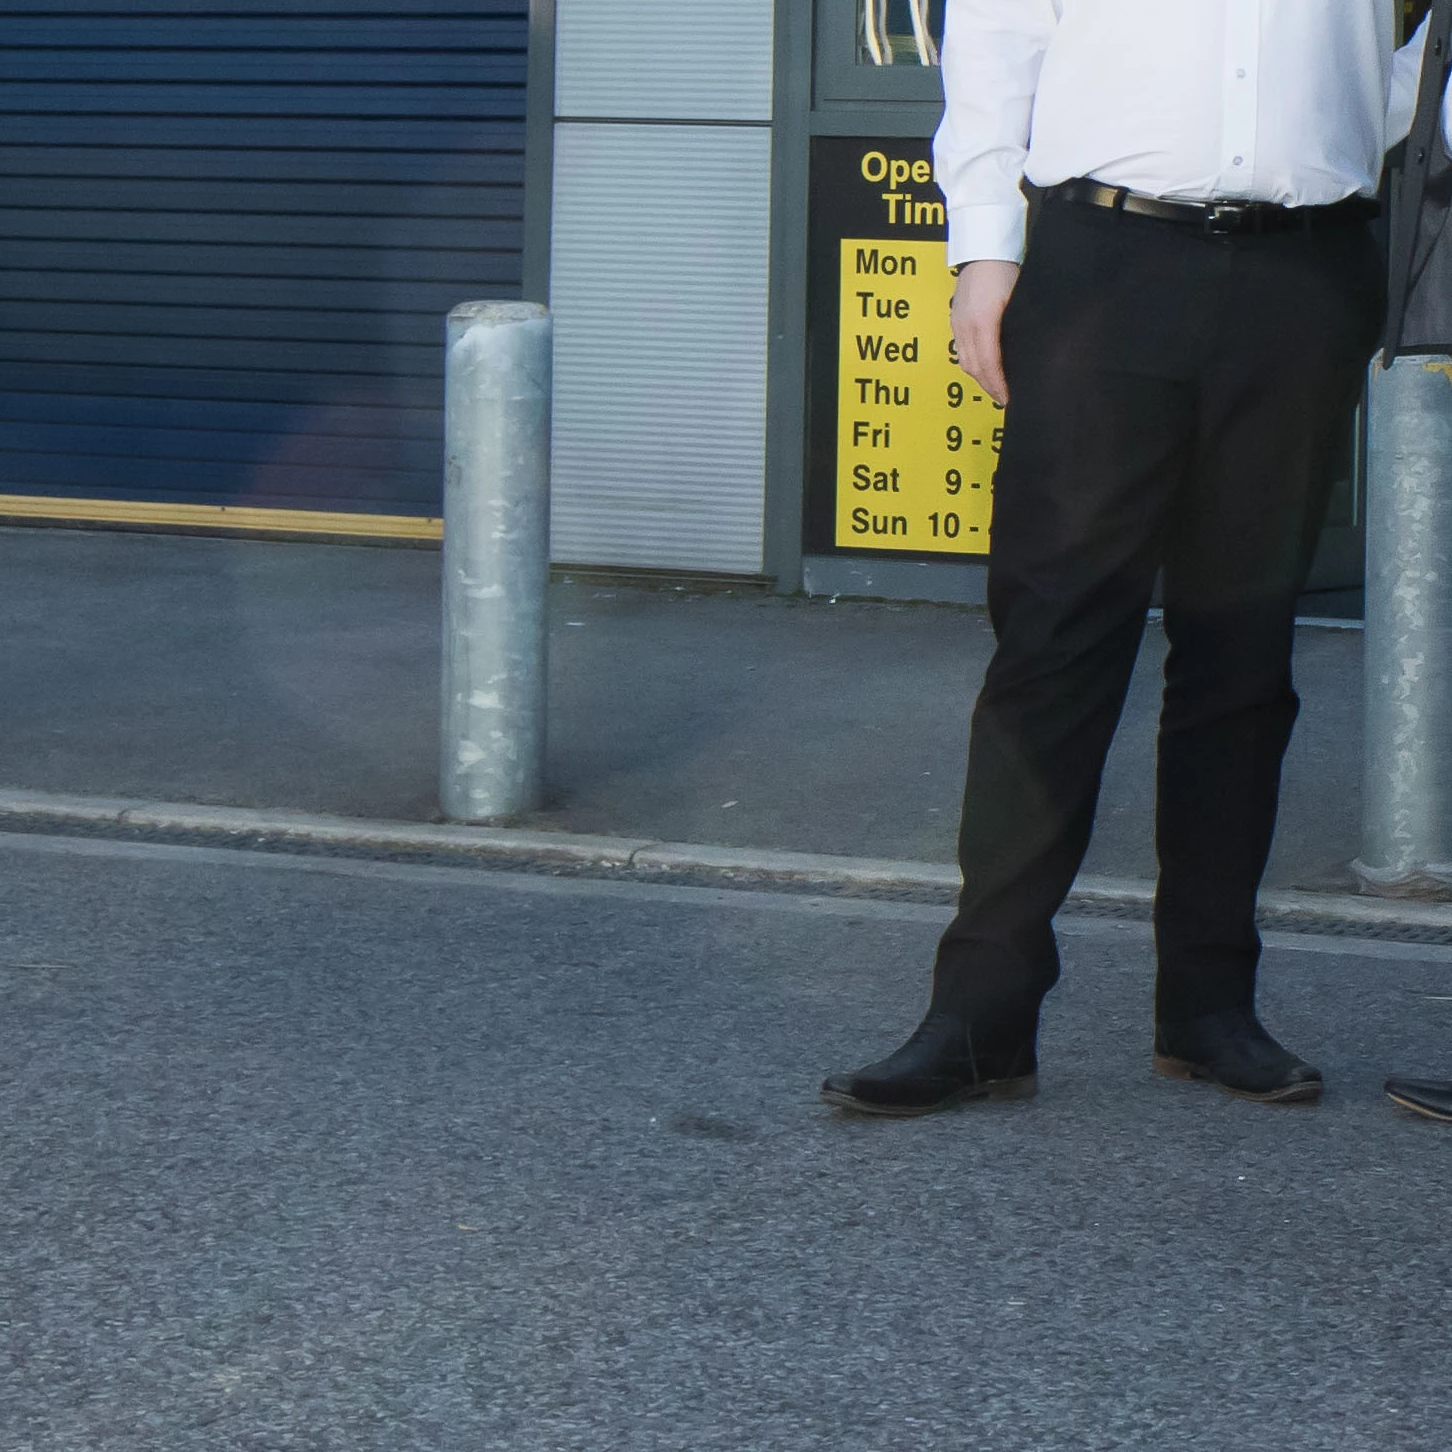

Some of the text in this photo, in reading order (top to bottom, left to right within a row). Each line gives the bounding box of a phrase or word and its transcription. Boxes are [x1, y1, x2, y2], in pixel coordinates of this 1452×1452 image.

[861, 151, 936, 190] Ope
[882, 193, 945, 225] Tim
[856, 249, 917, 276] Mon
[857, 292, 910, 318] Tue
[857, 335, 919, 363] Wed
[856, 379, 909, 405] Thu
[947, 382, 963, 408] 9
[853, 422, 890, 448] Fri
[946, 425, 962, 451] 9
[852, 465, 900, 492] Sat
[946, 469, 961, 495] 9
[852, 509, 908, 535] Sun
[929, 512, 960, 538] 10
